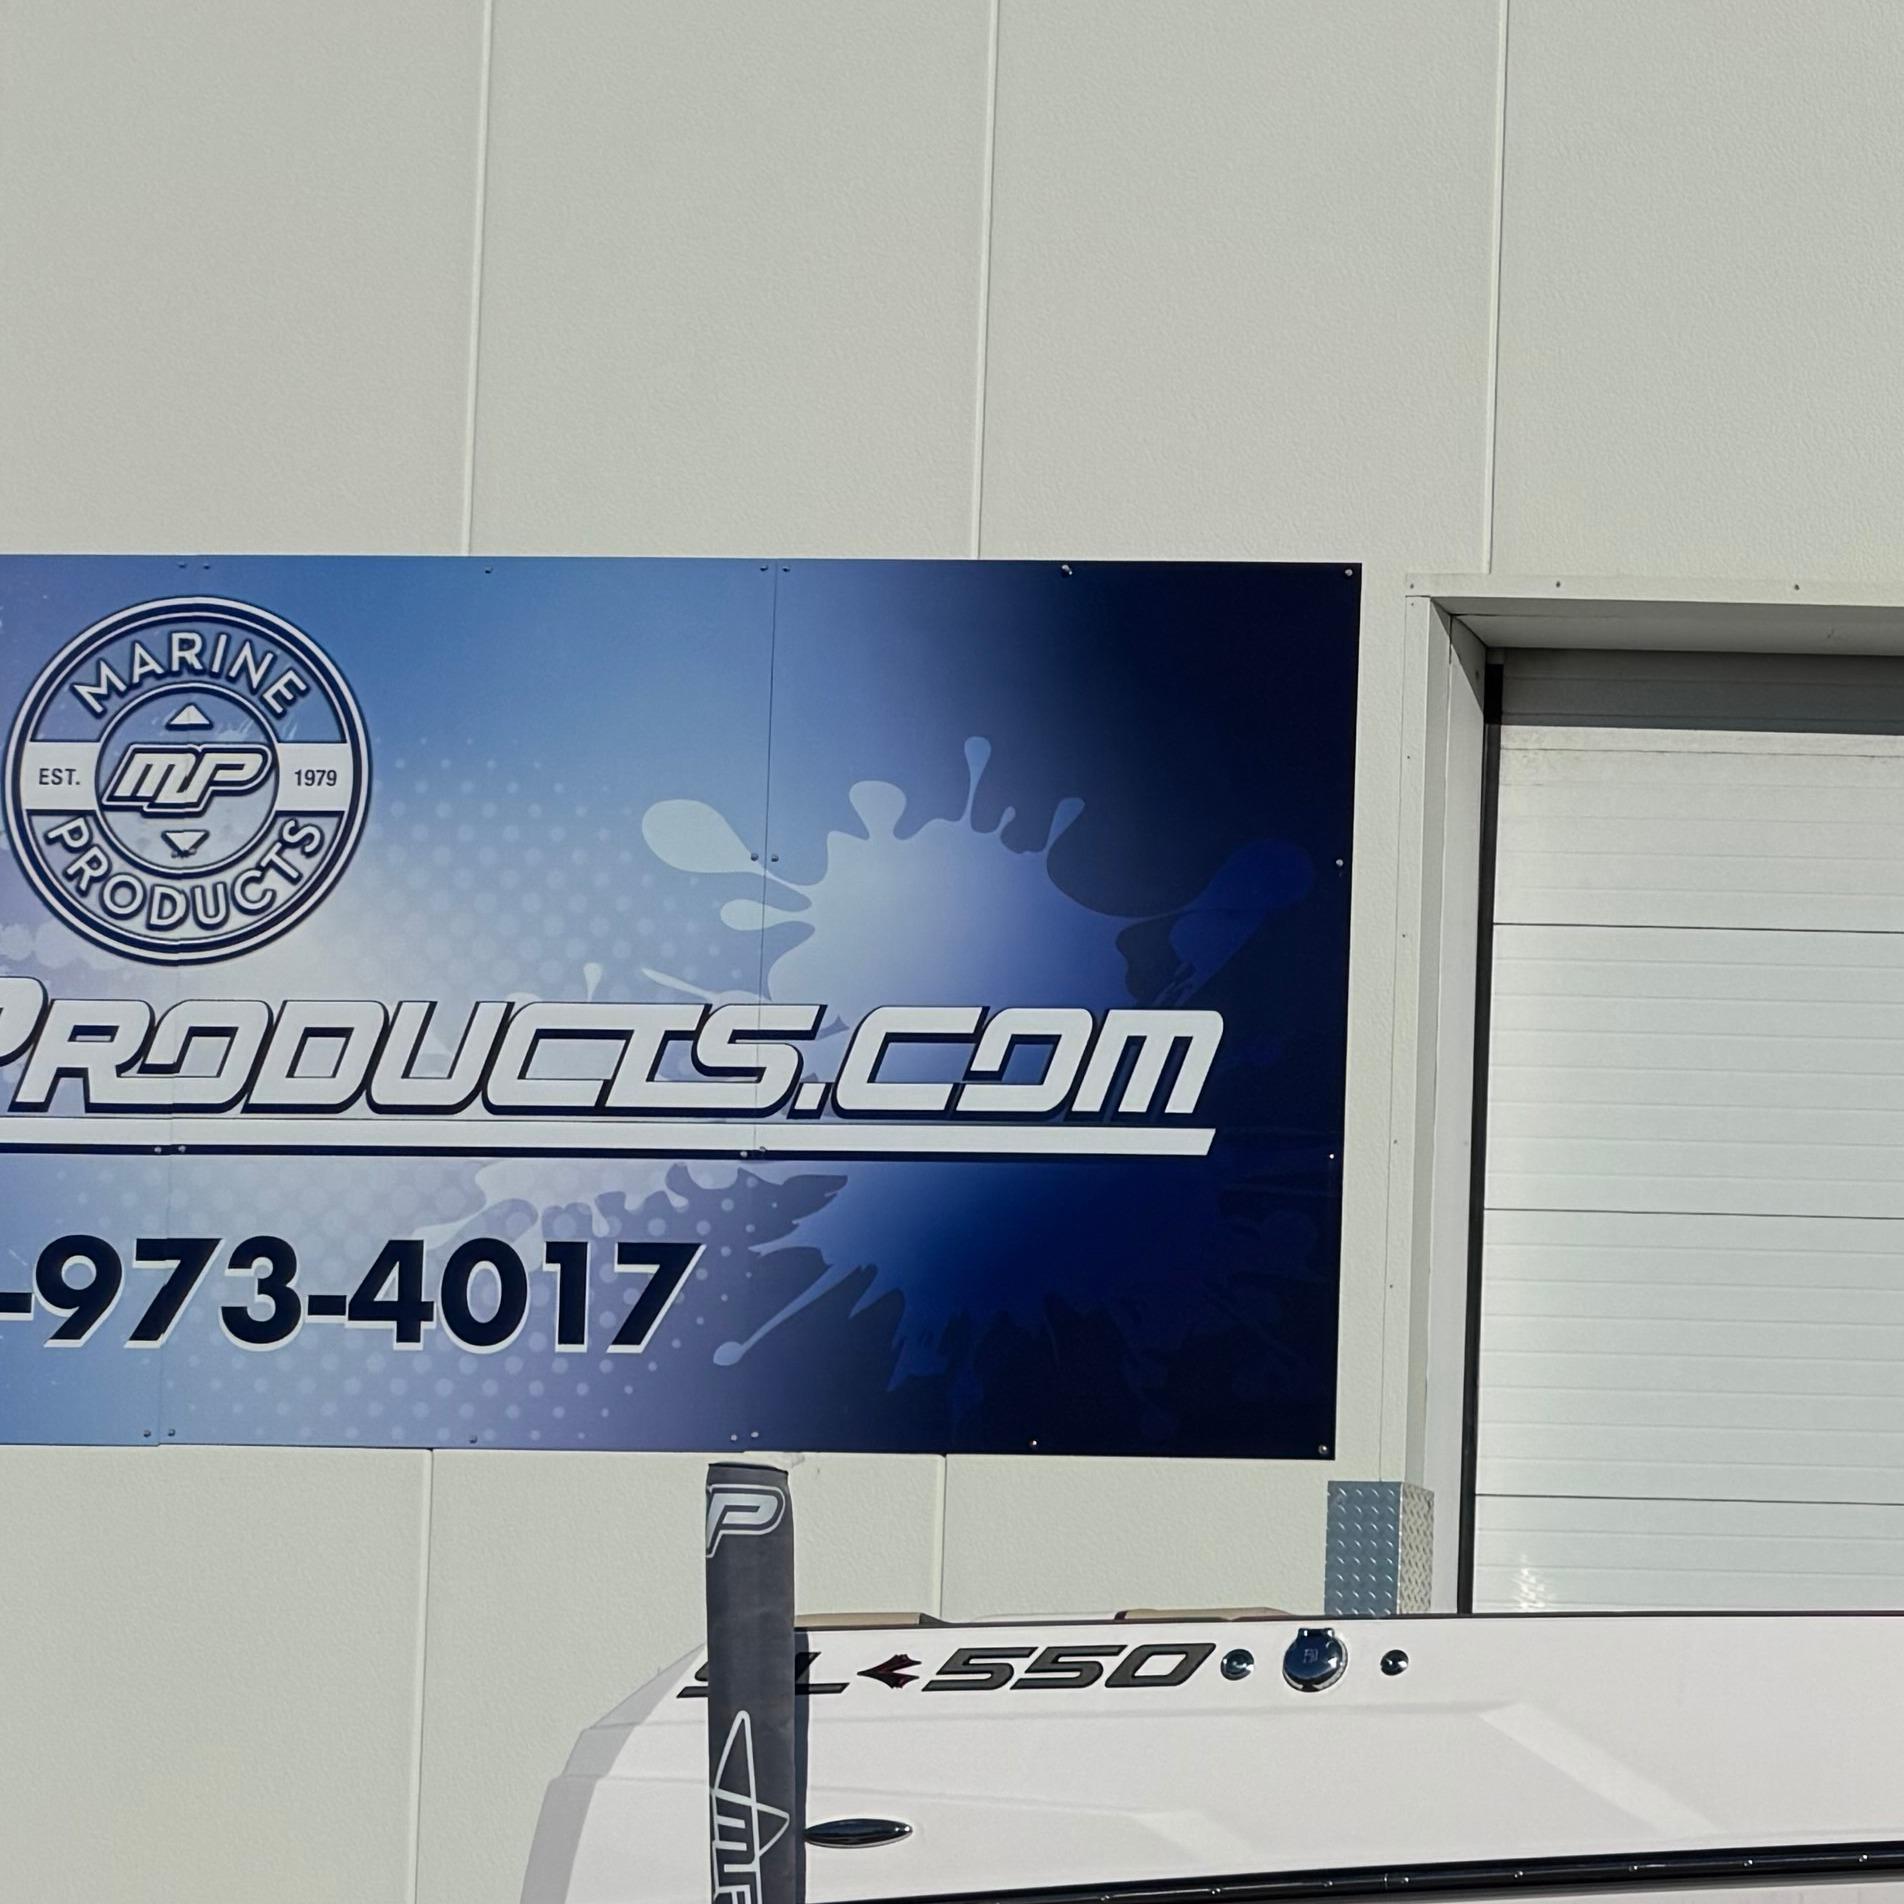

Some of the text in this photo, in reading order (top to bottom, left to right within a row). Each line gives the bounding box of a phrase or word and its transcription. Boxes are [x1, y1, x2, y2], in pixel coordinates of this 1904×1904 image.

[72, 630, 307, 717] MARINE
[38, 767, 81, 787] EST.
[293, 768, 338, 788] 1979
[46, 816, 325, 929] PRODUCTS
[921, 1642, 1216, 1692] 550
